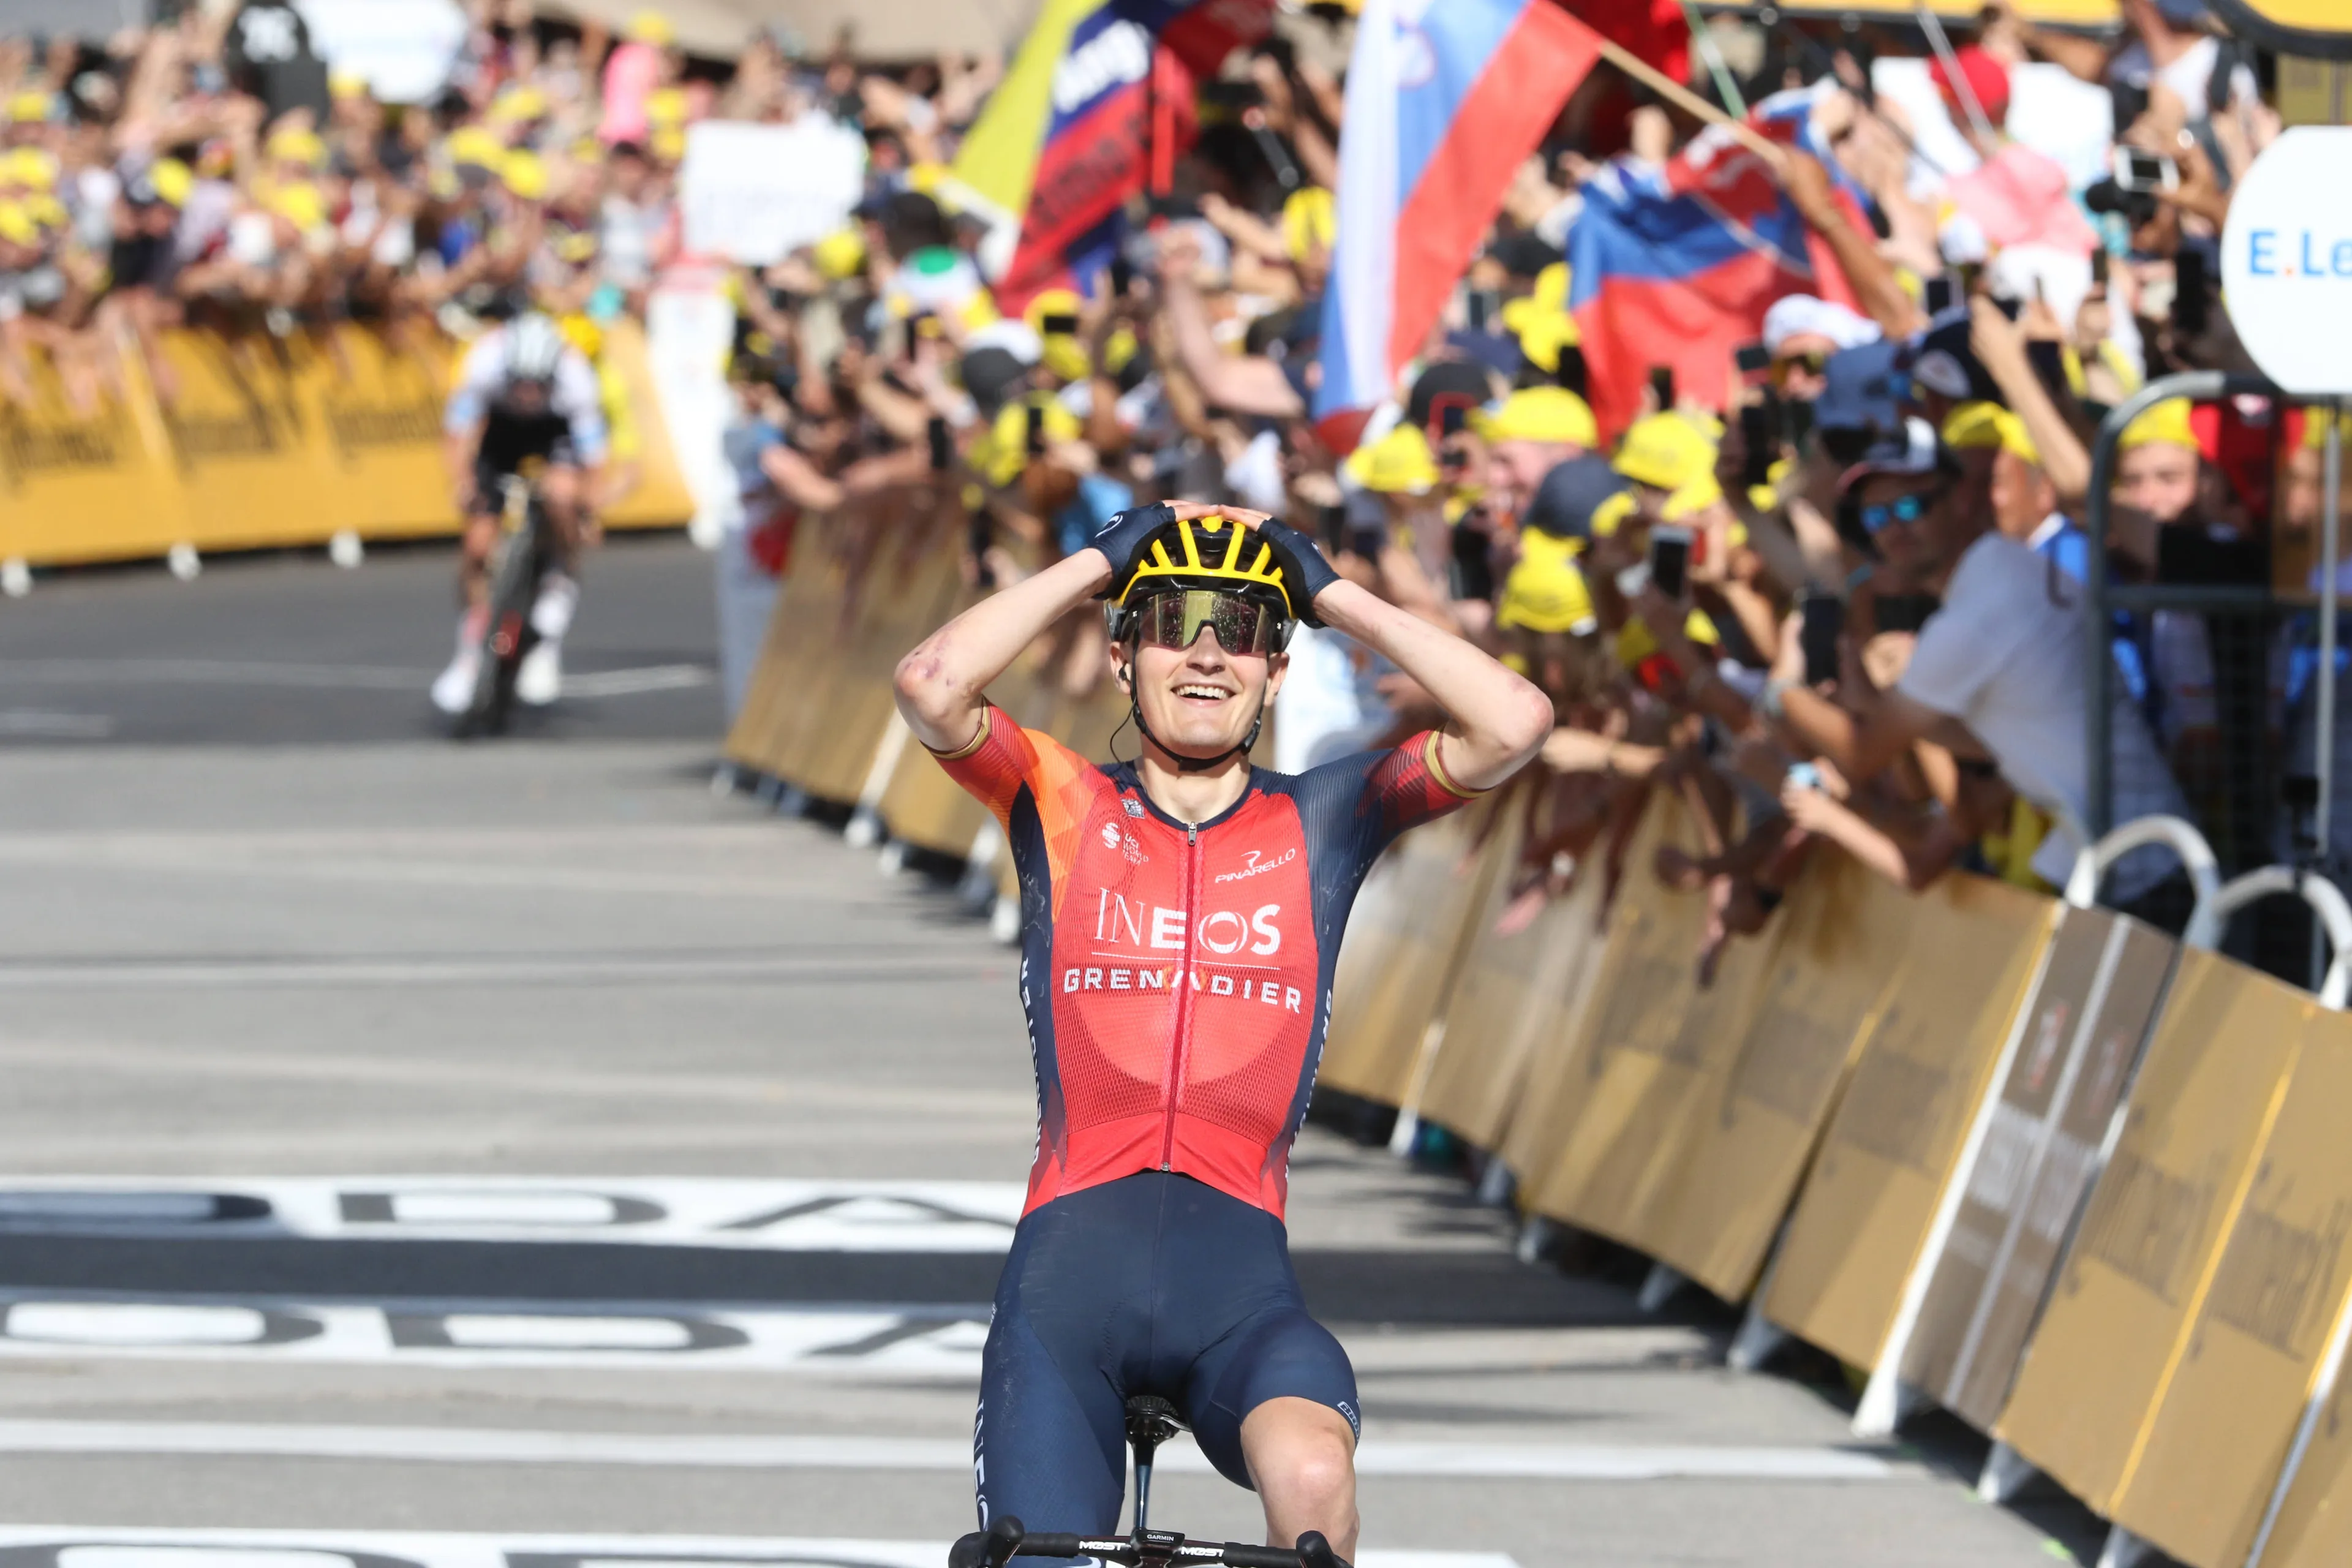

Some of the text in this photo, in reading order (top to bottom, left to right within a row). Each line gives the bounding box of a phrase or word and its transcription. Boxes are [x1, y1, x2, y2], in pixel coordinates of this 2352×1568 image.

[1123, 840, 1149, 862] WORLD
[1125, 833, 1139, 849] UCI
[1215, 848, 1296, 883] PINARELLO
[1094, 887, 1281, 956] INEOS
[1063, 967, 1301, 1014] GRENADIER
